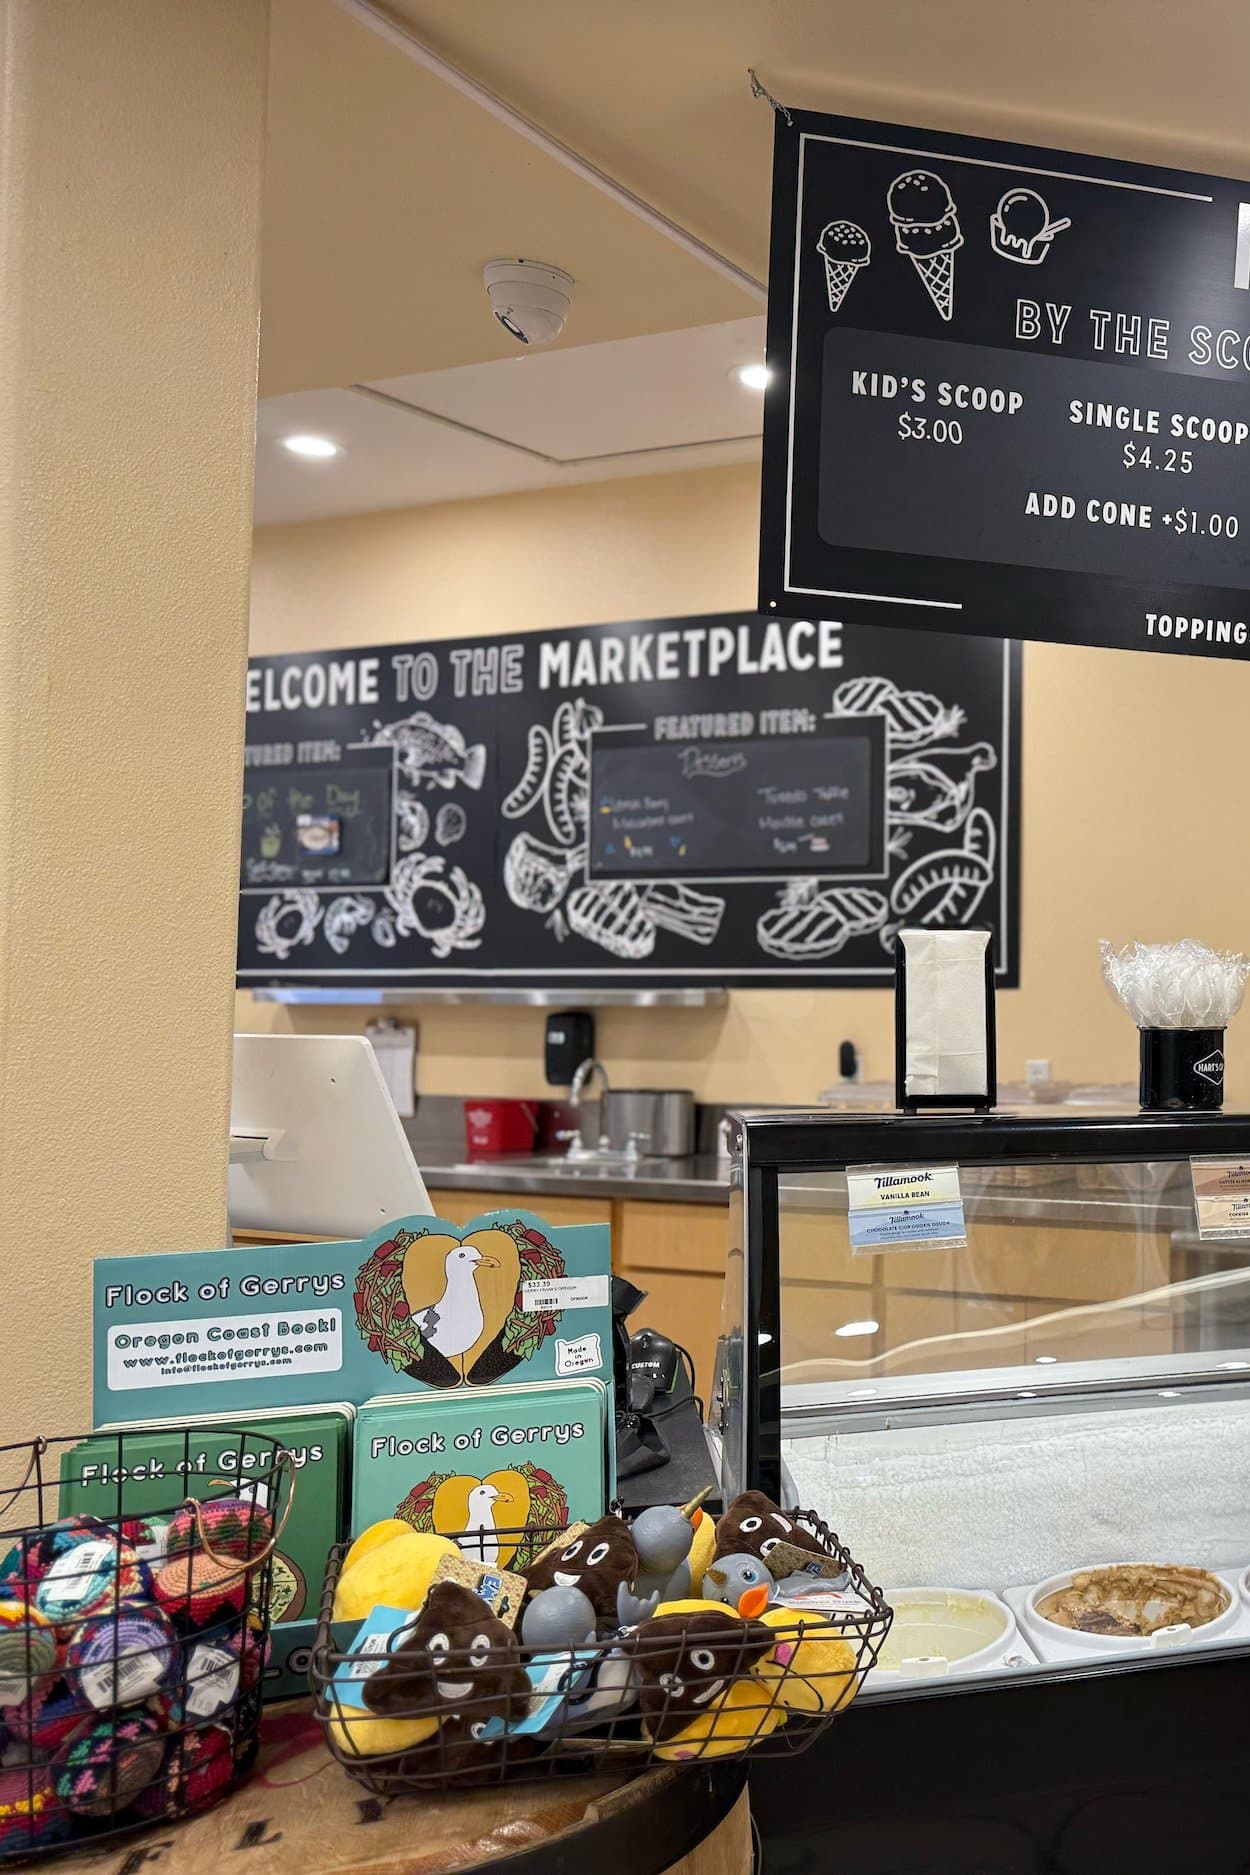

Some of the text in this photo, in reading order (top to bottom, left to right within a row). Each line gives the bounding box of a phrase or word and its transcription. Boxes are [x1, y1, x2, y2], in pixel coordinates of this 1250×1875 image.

[1015, 298, 1072, 345] BY
[1089, 309, 1170, 360] THE
[852, 370, 1023, 415] KID'S SCOOP
[897, 411, 963, 445] $3.00
[1069, 399, 1249, 445] SINGLE SCOOP
[1122, 440, 1193, 474] $4.25
[1024, 492, 1239, 539] ADD CONE +$1.00
[246, 621, 843, 712] ELCOME TO THE MARKETPLACE
[654, 708, 817, 741] FEATURED ITEM:
[245, 744, 293, 767] TURED
[874, 1172, 932, 1189] Tillamook
[880, 1192, 910, 1200] VANILLA
[889, 1212, 925, 1225] Tillamook
[105, 1273, 346, 1308] Flock of Gerrys
[115, 1329, 199, 1349] Oregon
[207, 1322, 270, 1342] Coast
[567, 1345, 587, 1355] Made
[123, 1342, 328, 1368] www.flockofgerrys.com
[565, 1357, 594, 1368] Oregon
[371, 1422, 584, 1459] Flock of Gerrys
[81, 1457, 165, 1487] Flock
[176, 1452, 207, 1476] of
